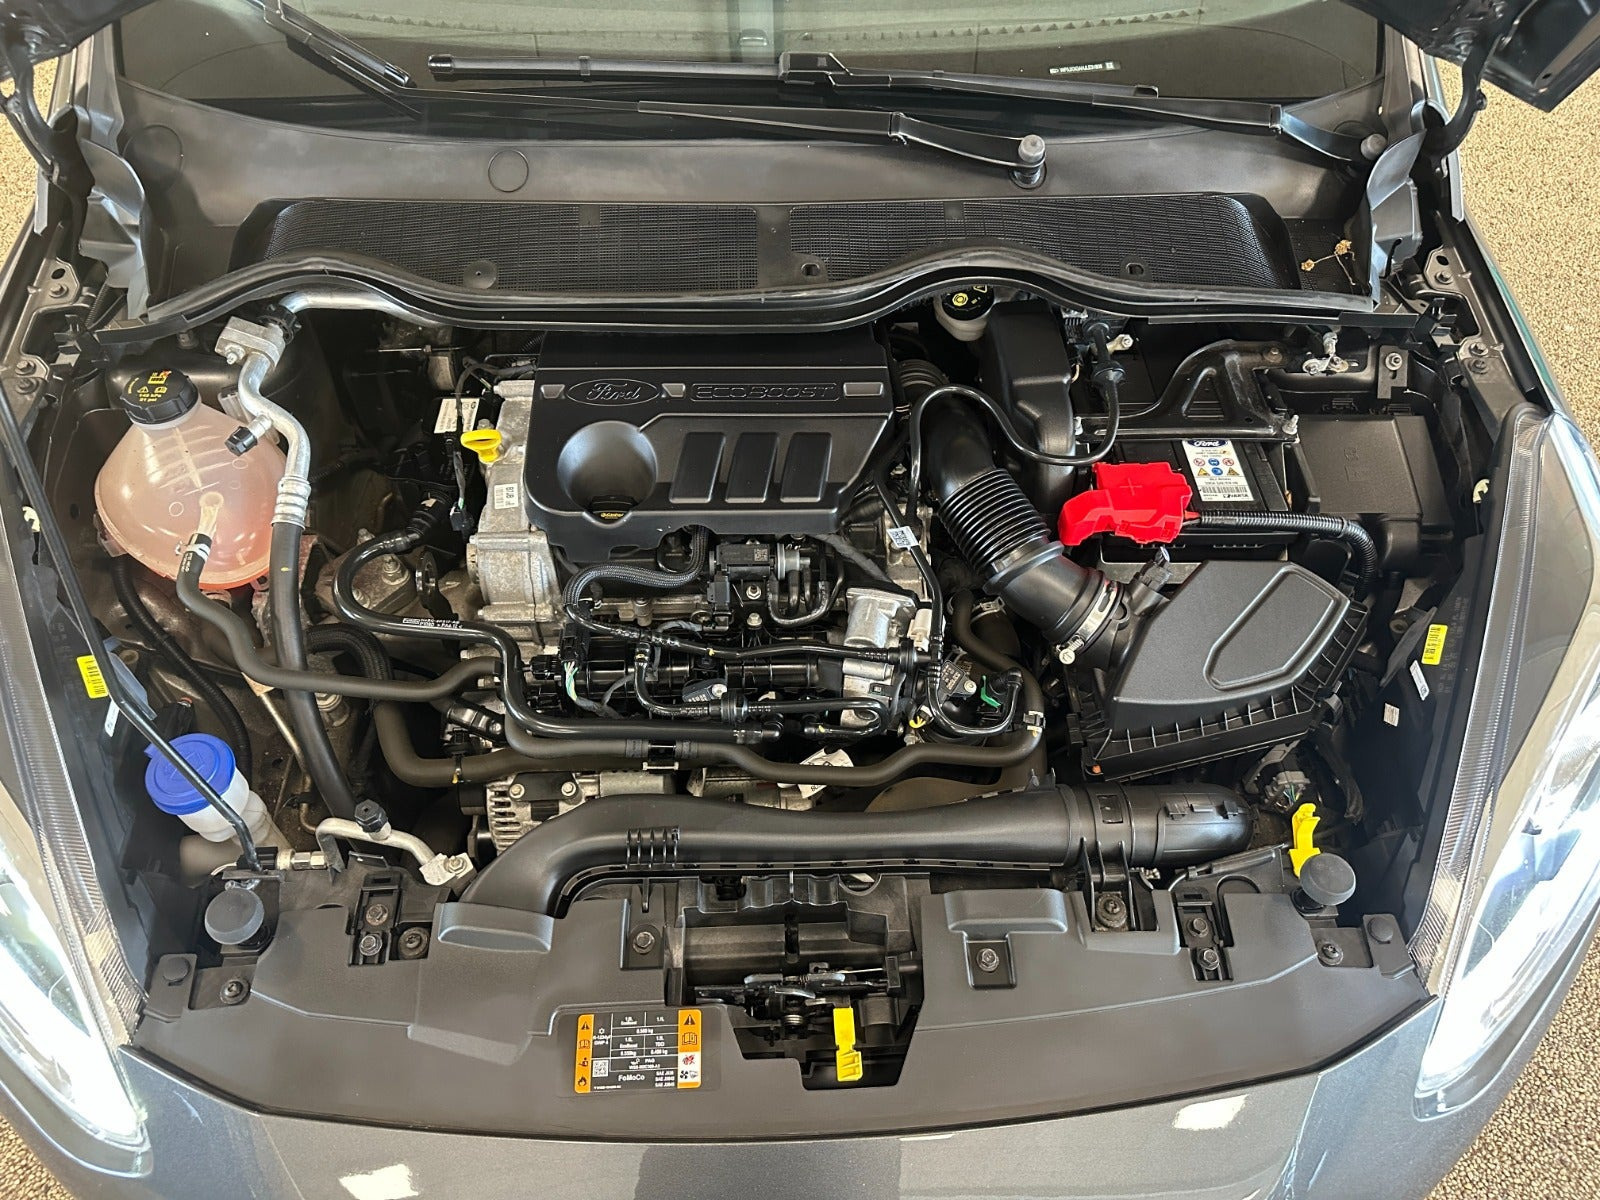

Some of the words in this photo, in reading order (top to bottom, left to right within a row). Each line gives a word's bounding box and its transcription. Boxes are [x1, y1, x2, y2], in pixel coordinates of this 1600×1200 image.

[586, 383, 642, 401] Ford
[697, 386, 834, 399] ECOBOOST
[618, 1074, 645, 1082] FoMoCo
